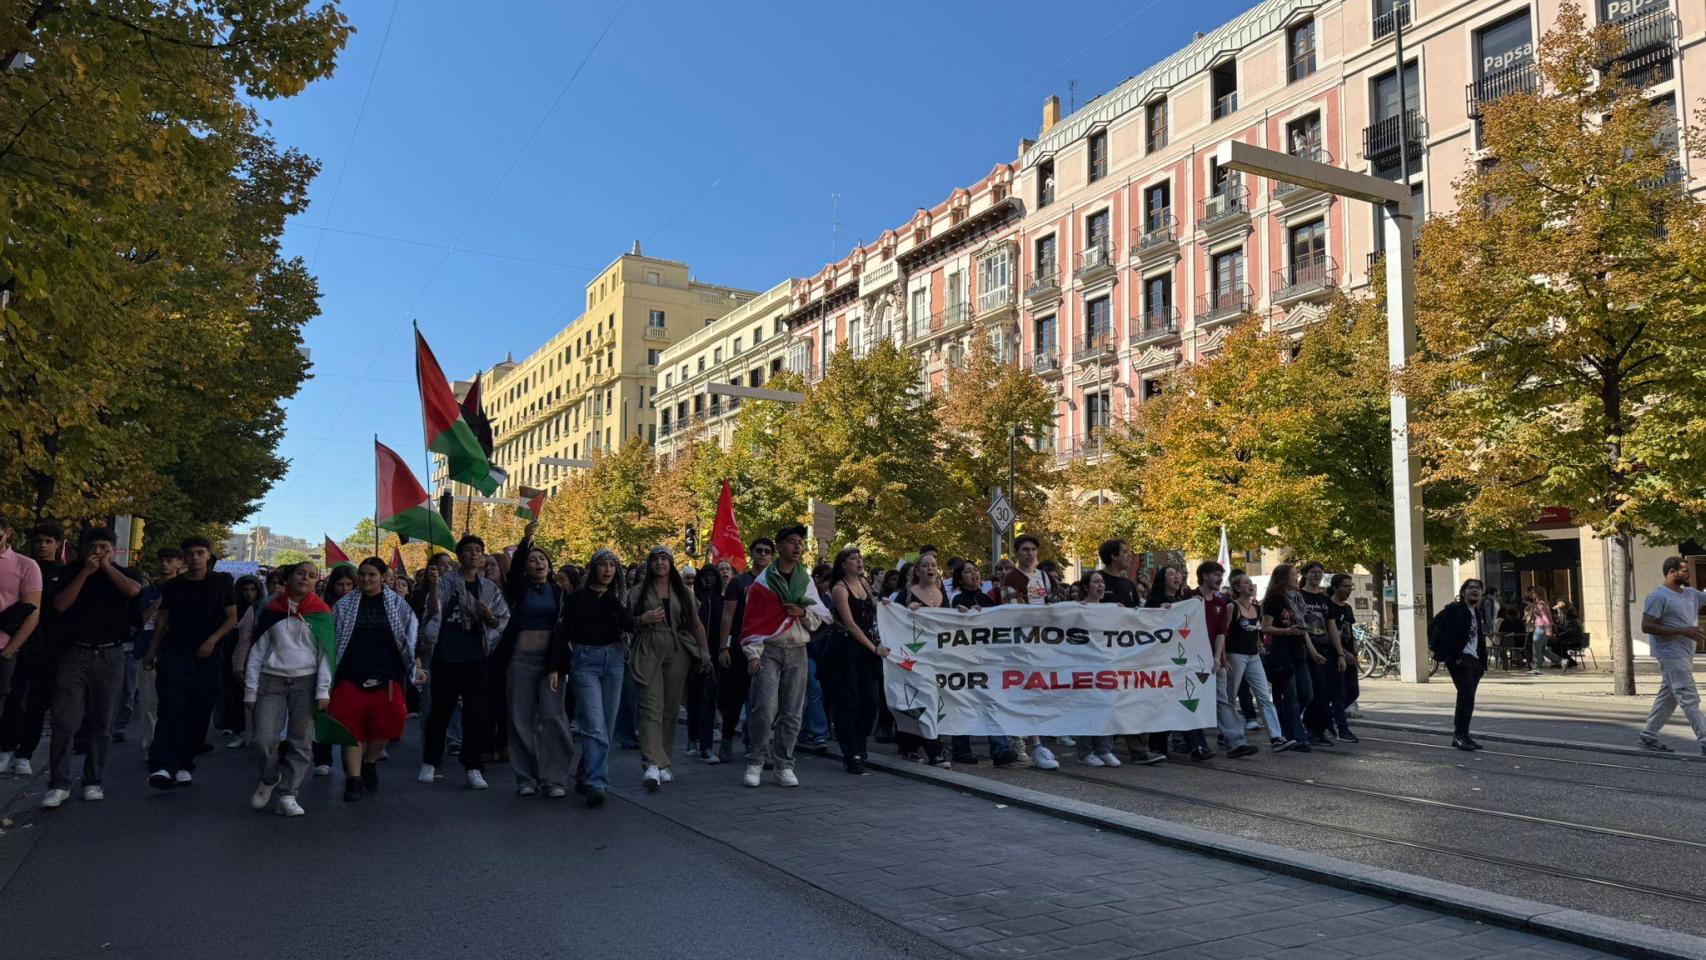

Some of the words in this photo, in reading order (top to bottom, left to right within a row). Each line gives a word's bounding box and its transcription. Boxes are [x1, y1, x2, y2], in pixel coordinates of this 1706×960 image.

[1484, 43, 1532, 73] Papsa
[996, 507, 1010, 522] 30
[937, 626, 1090, 649] PAREMOS
[1103, 628, 1174, 648] TODO
[935, 671, 989, 691] POR
[1002, 670, 1174, 691] PALESTINA
